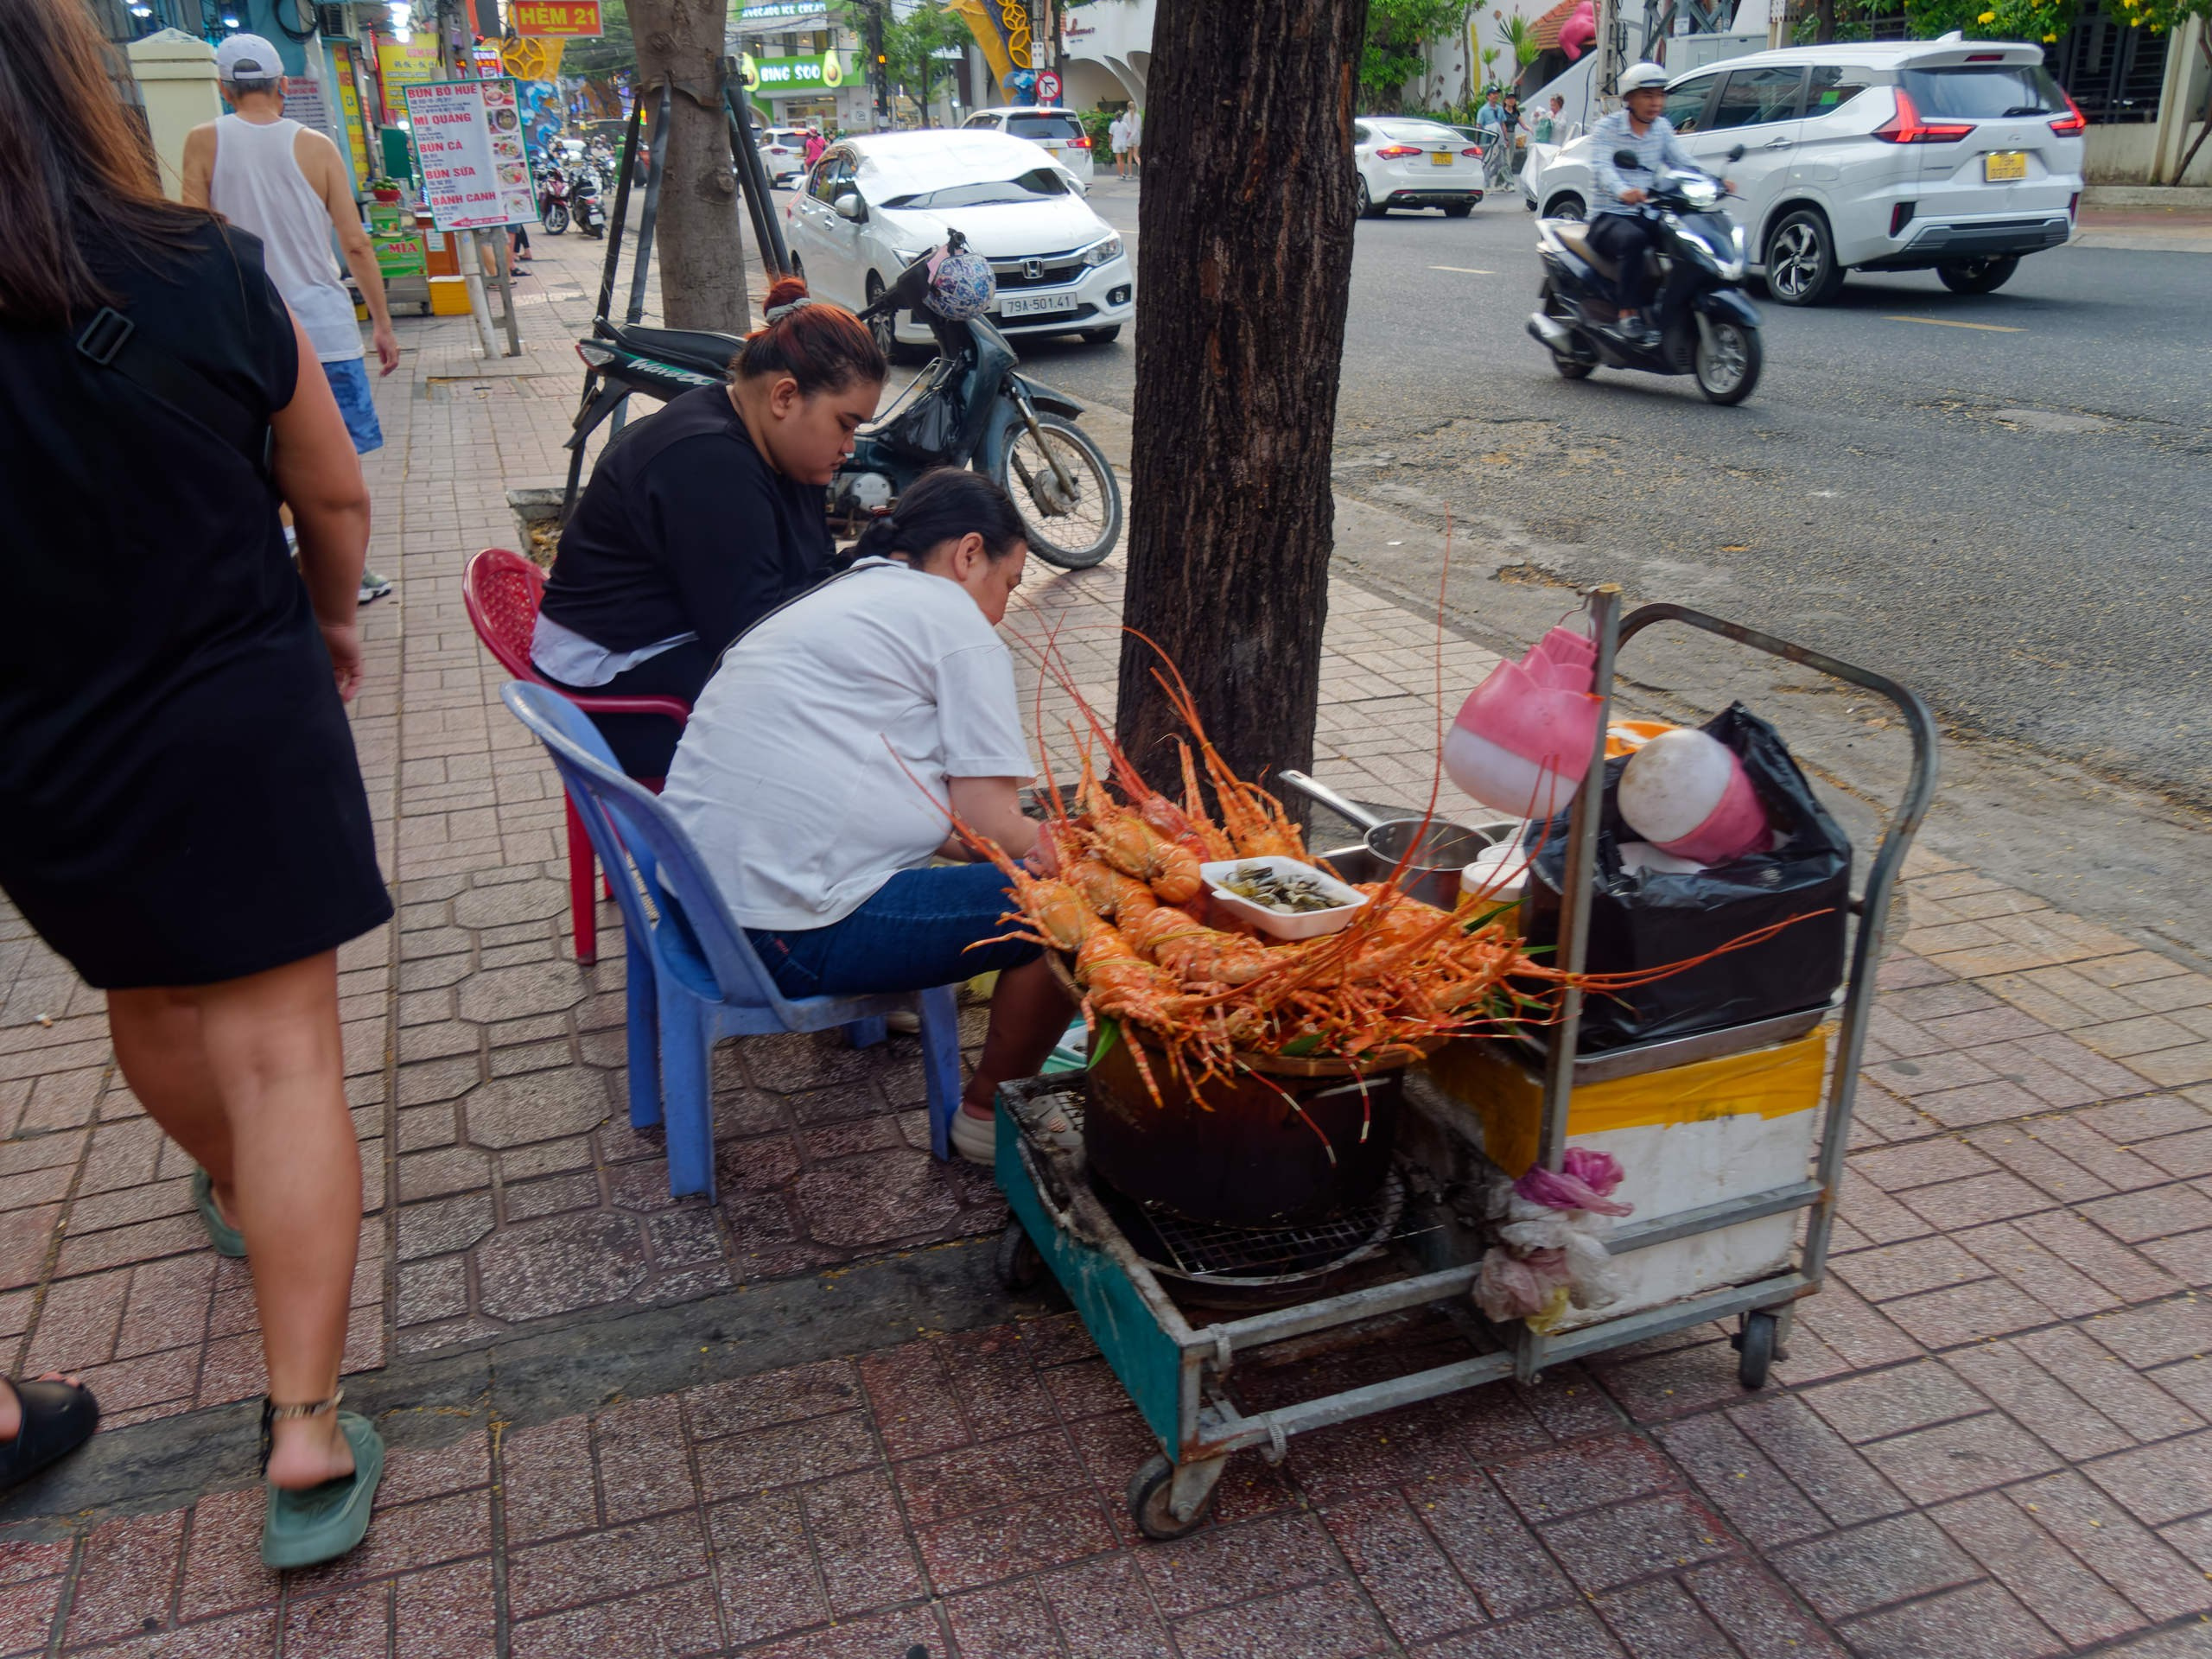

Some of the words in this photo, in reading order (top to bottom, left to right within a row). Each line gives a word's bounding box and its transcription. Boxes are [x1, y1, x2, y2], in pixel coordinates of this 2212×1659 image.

[574, 8, 596, 25] 21
[742, 7, 779, 18] AVOCADO
[781, 5, 796, 15] ICE
[798, 3, 826, 14] CREAM
[760, 65, 791, 82] BING
[794, 64, 820, 79] SOO
[467, 192, 496, 202] CANH
[1007, 296, 1071, 313] 79A-501.41
